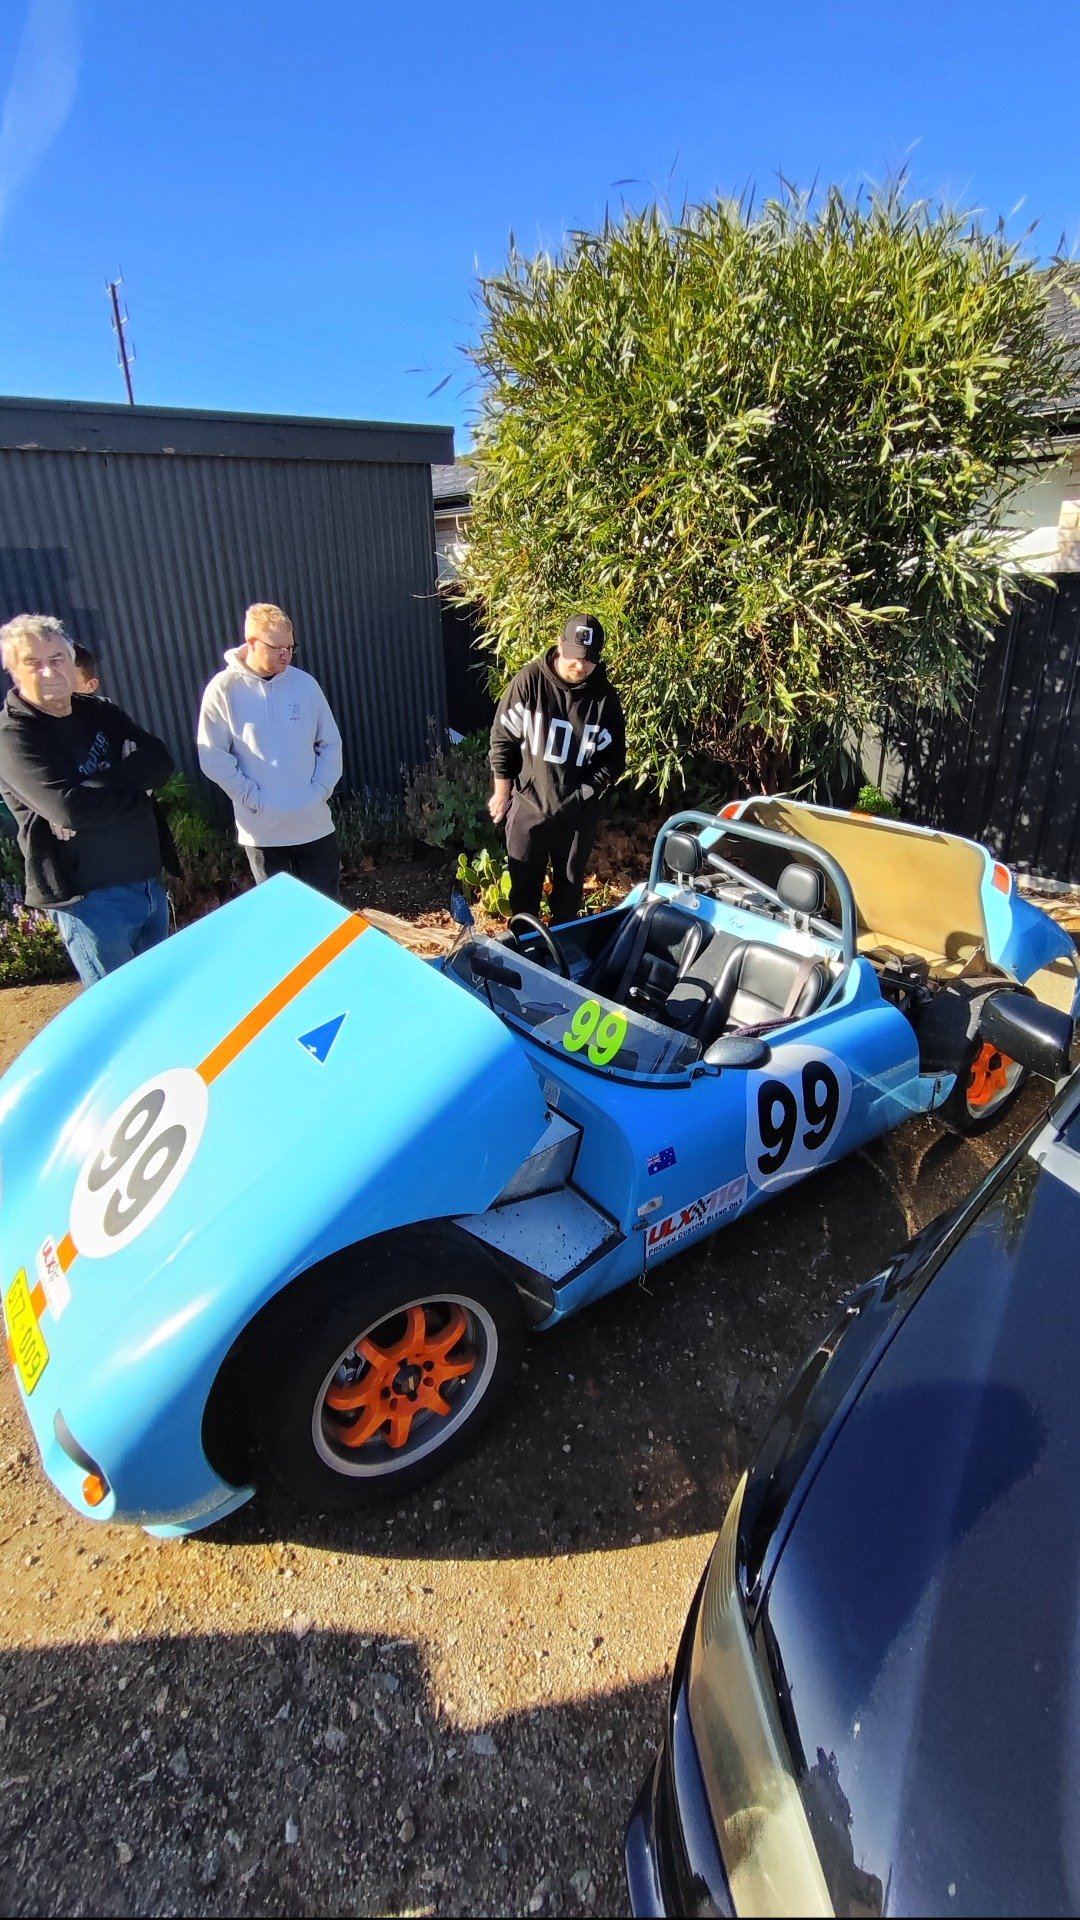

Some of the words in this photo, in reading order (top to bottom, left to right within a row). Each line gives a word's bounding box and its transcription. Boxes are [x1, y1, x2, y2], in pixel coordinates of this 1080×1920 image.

[562, 999, 628, 1066] 99
[87, 1088, 187, 1237] 99
[757, 1060, 840, 1176] 99
[648, 1236, 676, 1256] PROVEN
[678, 1219, 705, 1239] CUSTOM
[707, 1208, 727, 1224] BLEND
[729, 1198, 744, 1211] OILS
